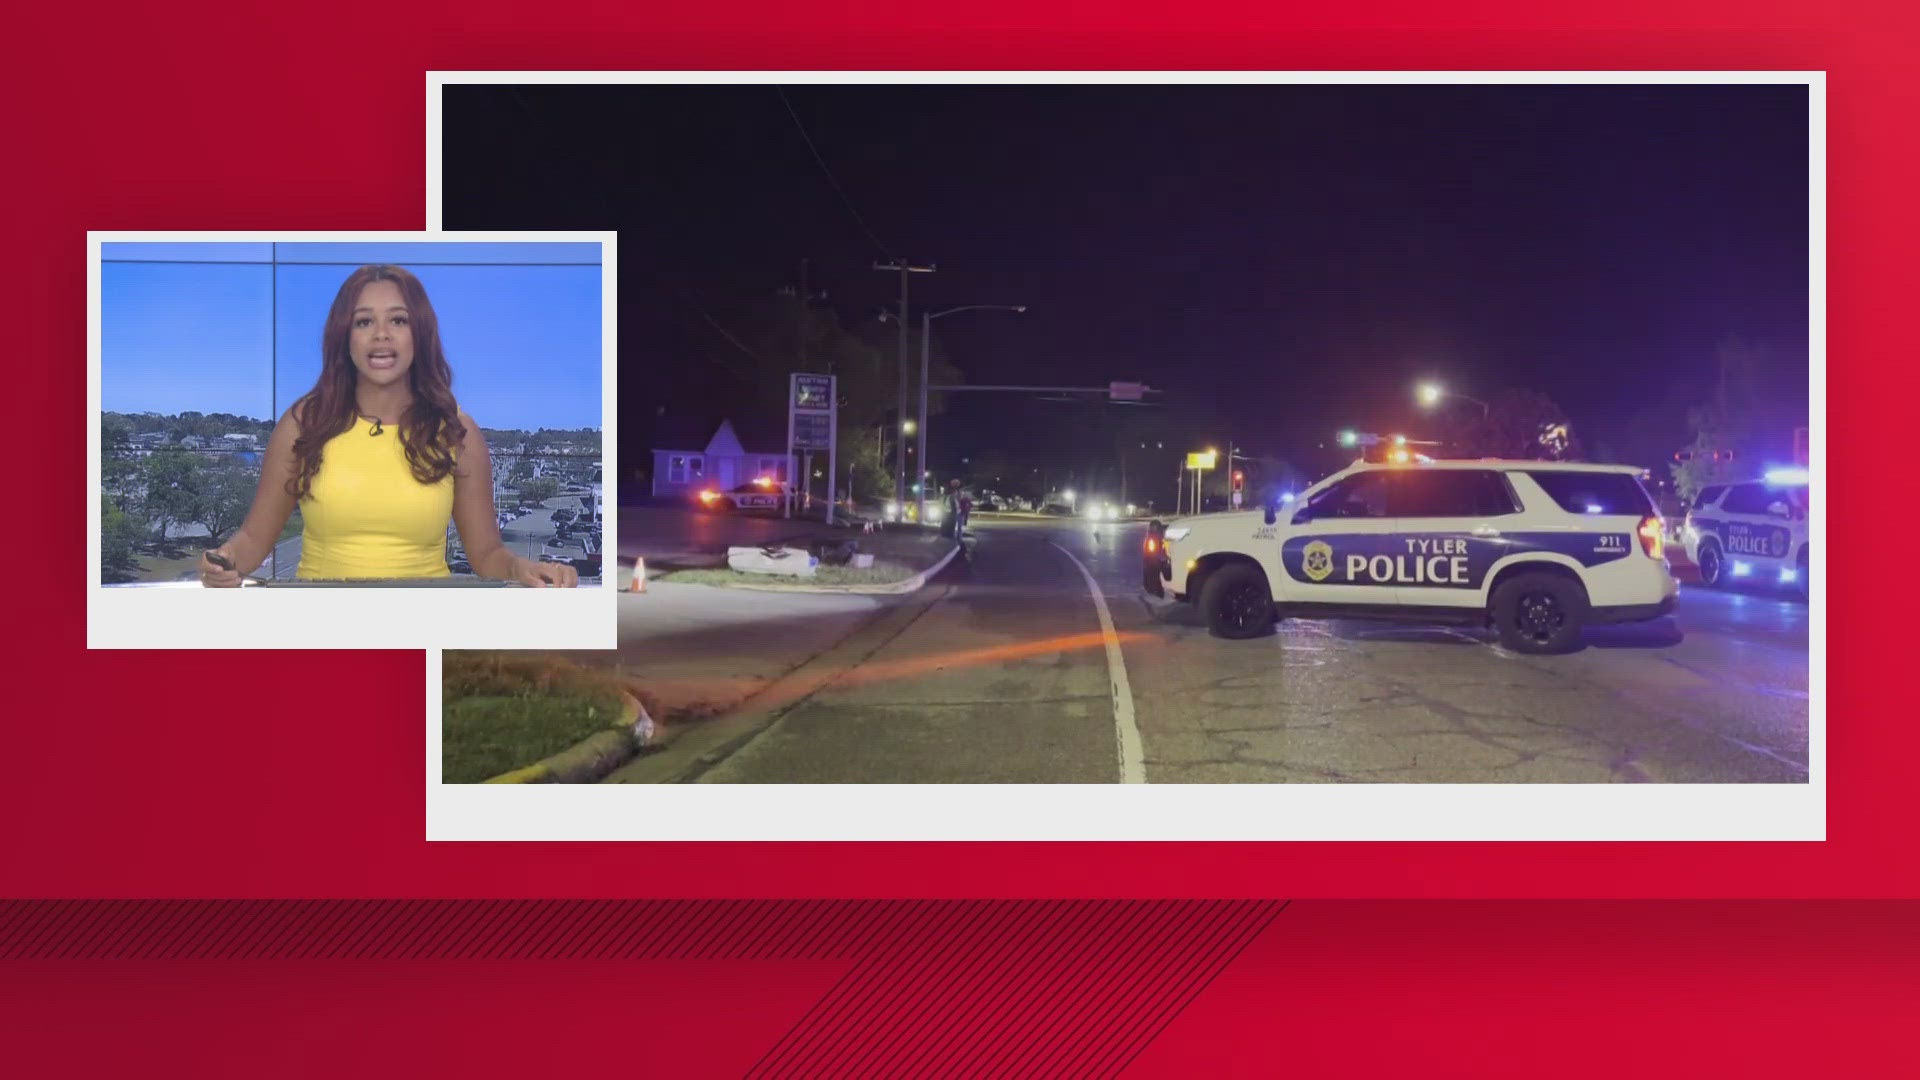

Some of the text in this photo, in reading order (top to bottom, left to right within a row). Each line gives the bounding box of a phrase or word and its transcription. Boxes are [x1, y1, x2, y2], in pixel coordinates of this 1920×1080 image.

[1405, 539, 1467, 554] TYLER
[1600, 535, 1620, 547] 911
[1728, 535, 1768, 555] POLICE
[1347, 554, 1470, 583] POLICE
